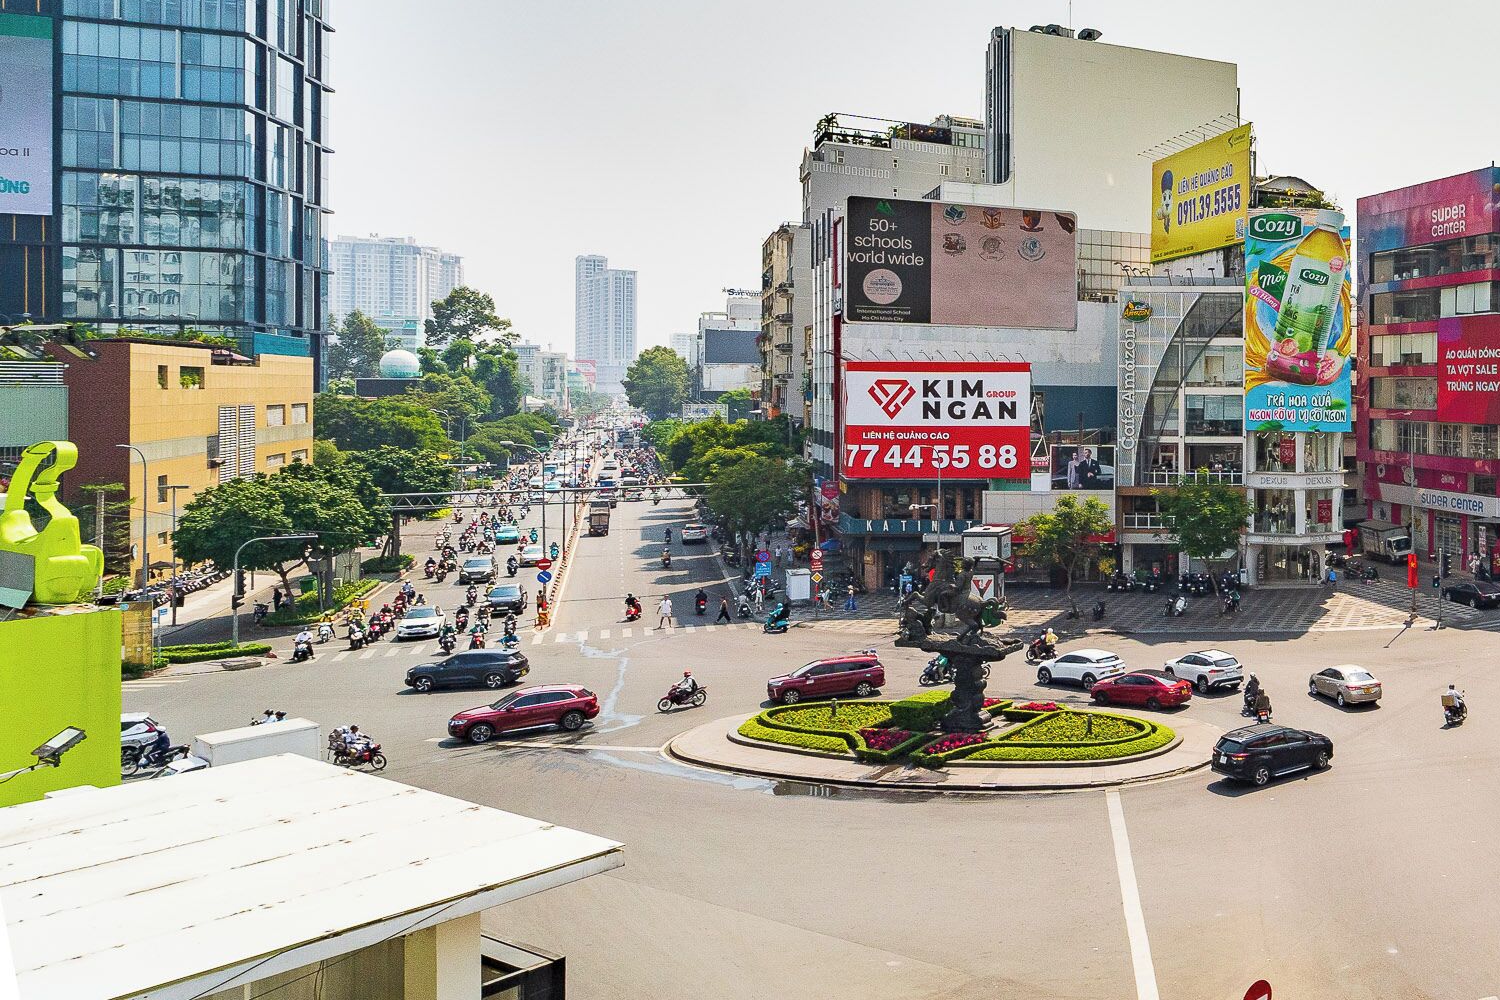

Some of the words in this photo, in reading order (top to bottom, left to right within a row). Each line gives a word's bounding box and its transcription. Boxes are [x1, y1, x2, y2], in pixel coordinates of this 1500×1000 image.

[1178, 176, 1190, 194] LIÊN
[1190, 172, 1198, 192] HỆ
[1200, 167, 1220, 187] QUẢNG
[1177, 183, 1241, 226] 0911.39.5555
[869, 218, 898, 232] 50+
[1254, 217, 1297, 236] Cozy
[854, 234, 912, 250] schools
[887, 252, 924, 266] wide
[1302, 270, 1327, 284] Cozy
[1121, 328, 1136, 400] Amazon
[1446, 364, 1456, 375] TA
[1457, 363, 1475, 377] VỢT
[1475, 364, 1498, 375] SALE
[922, 379, 984, 399] KIM
[985, 390, 1017, 398] GROUP
[1446, 378, 1474, 391] TRÚNG
[1475, 381, 1500, 391] NGAY
[1267, 392, 1285, 407] TRÀ
[1288, 395, 1307, 407] HOA
[1311, 391, 1332, 408] QUẢ
[922, 400, 1017, 420] NGAN
[1249, 409, 1271, 421] NGON
[1272, 407, 1285, 420] RÕ
[1286, 409, 1296, 424] VỊ
[1299, 409, 1309, 424] VỊ
[1310, 407, 1323, 421] RÕ
[1323, 410, 1347, 421] NGON
[862, 430, 882, 440] LIÊN
[882, 430, 895, 441] HỆ
[896, 429, 928, 440] QUẢNG
[929, 430, 950, 440] CÁO
[883, 444, 924, 468] 44
[931, 444, 970, 468] 55
[977, 444, 1018, 469] 88
[1260, 477, 1288, 485] DEXUS
[1305, 476, 1332, 485] DEXUS
[866, 520, 973, 533] KATINAT
